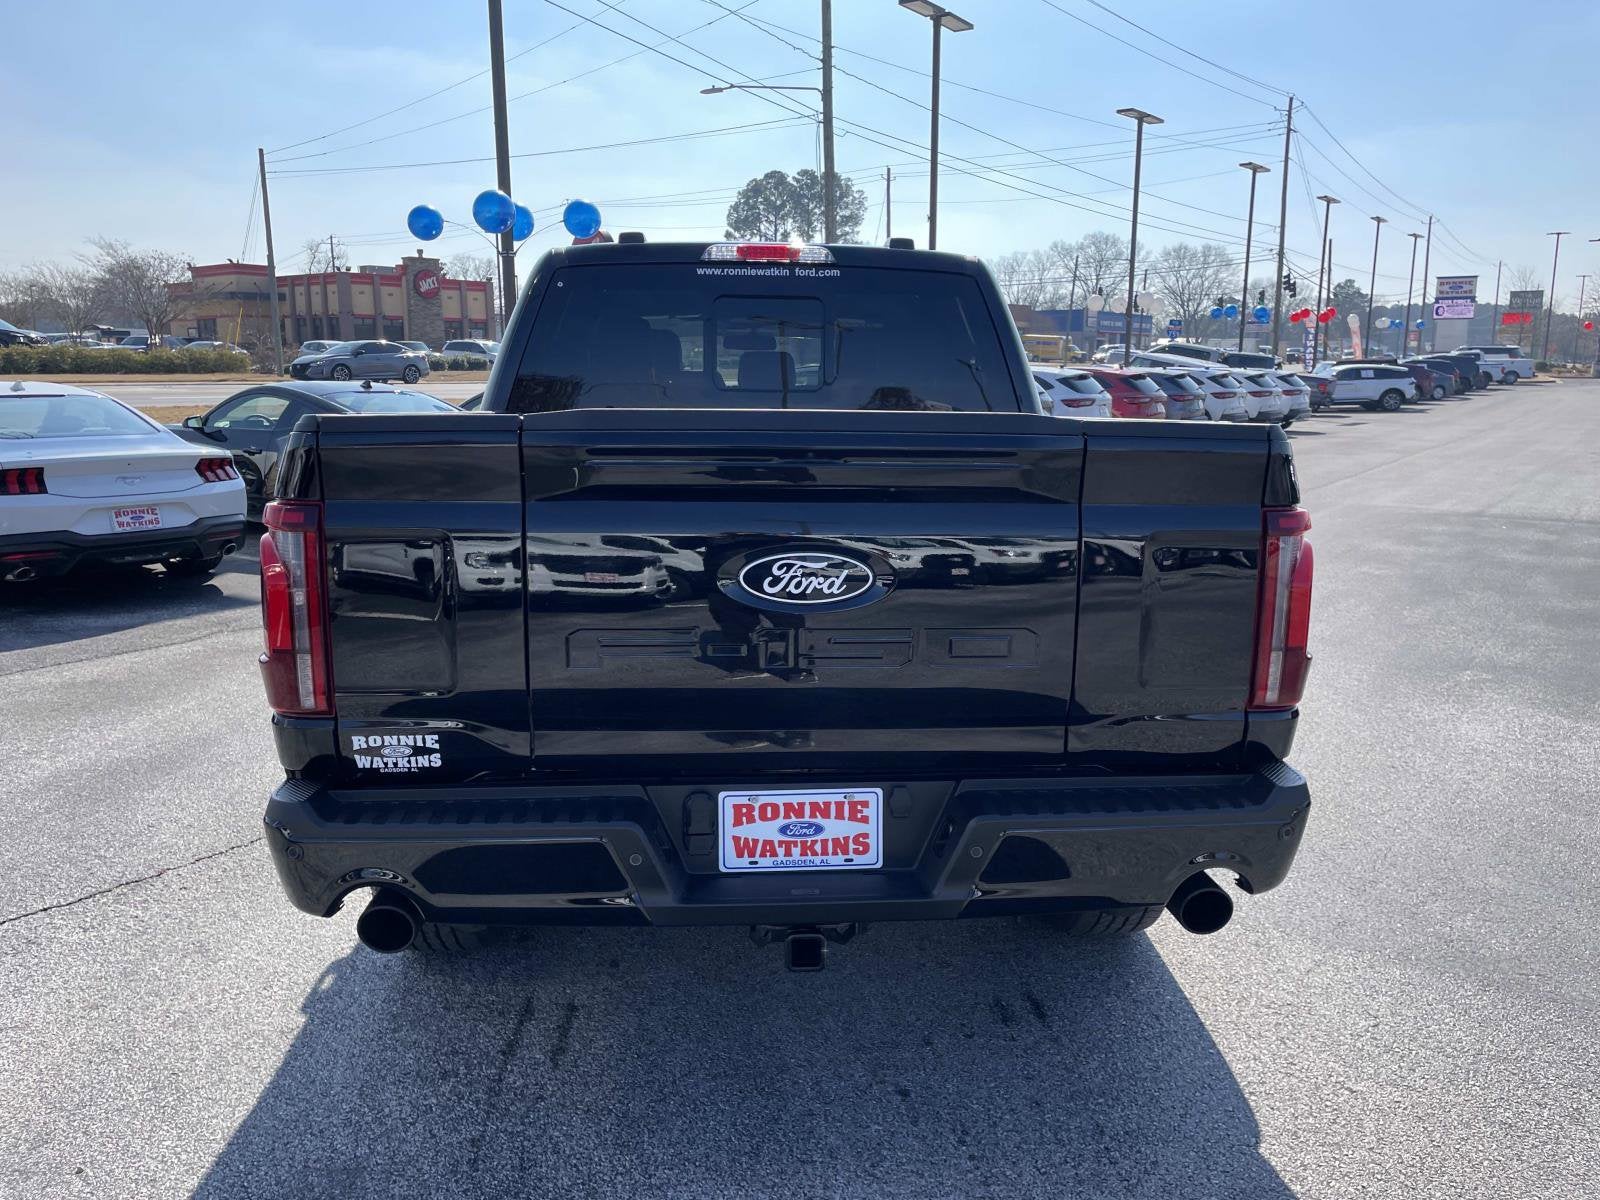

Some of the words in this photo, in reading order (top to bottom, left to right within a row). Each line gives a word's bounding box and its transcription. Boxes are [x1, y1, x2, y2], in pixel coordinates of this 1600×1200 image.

[114, 508, 158, 518] RONNIE
[116, 518, 160, 528] WATKINS
[763, 560, 847, 596] Ford
[352, 735, 440, 750] RONNIE
[353, 753, 442, 768] WATKINS
[732, 800, 870, 828] RONNIE
[786, 823, 816, 836] Ford
[732, 832, 871, 859] WATKINS
[772, 859, 817, 867] GADSDEN,
